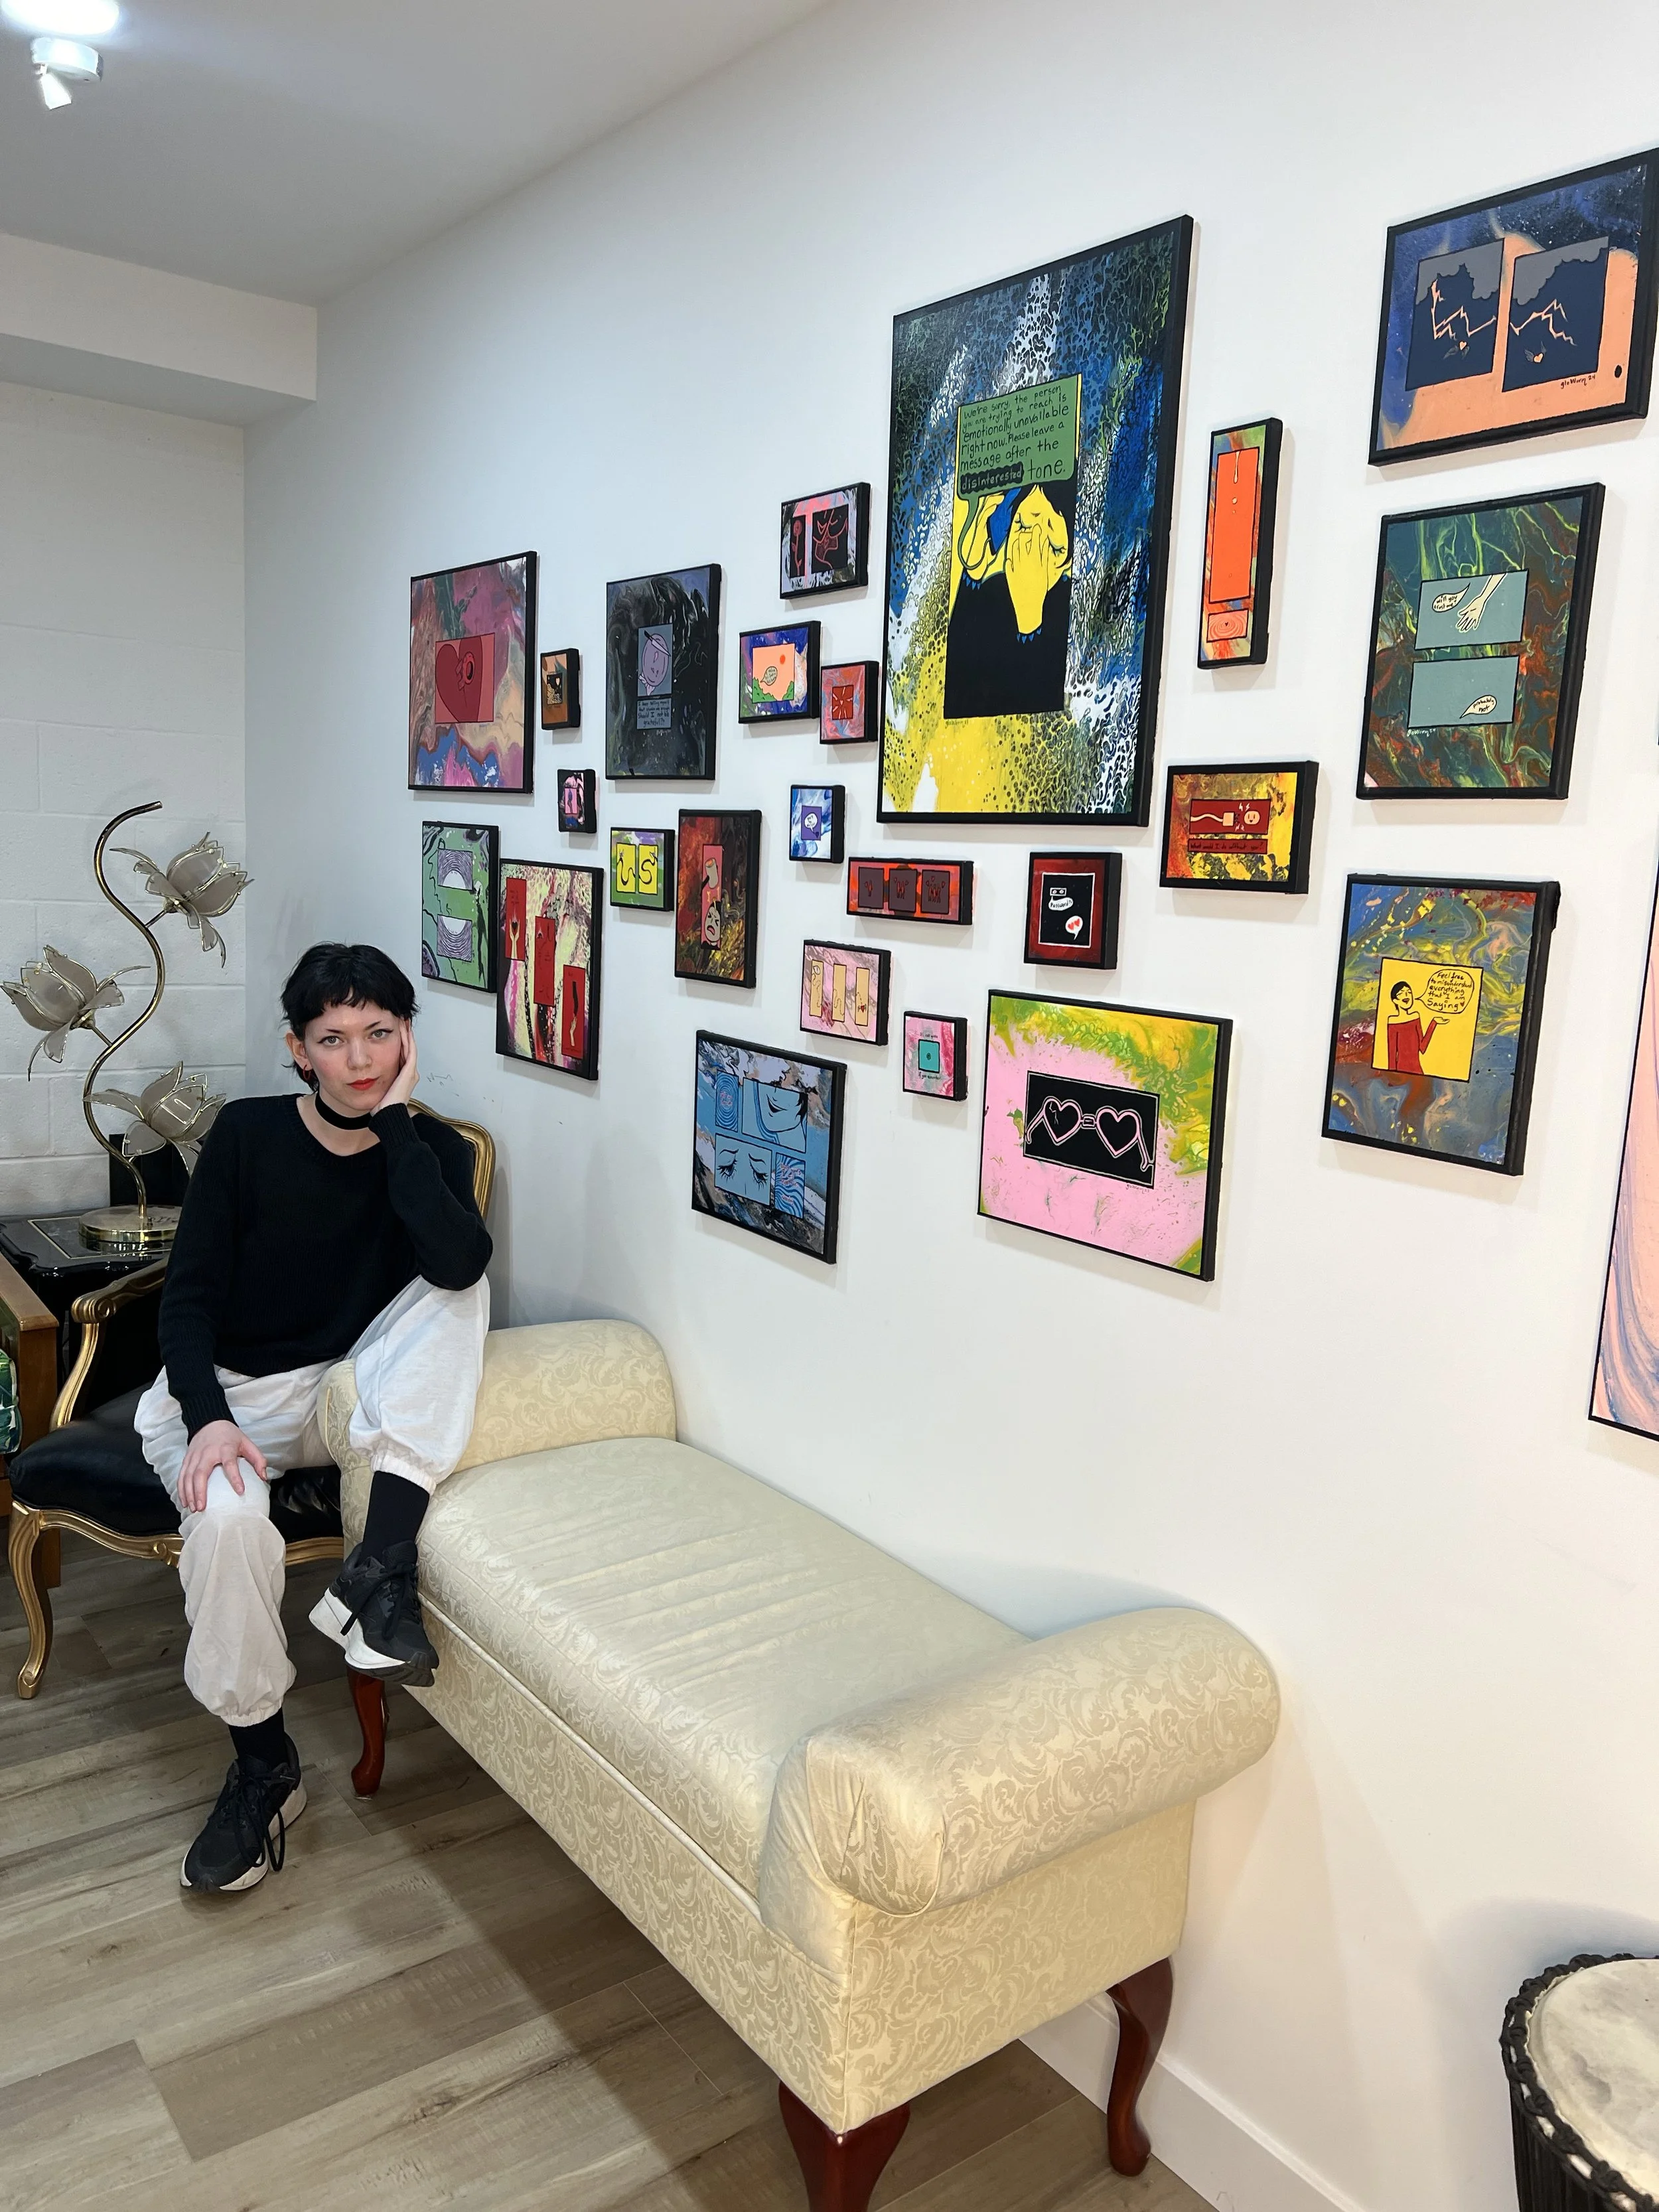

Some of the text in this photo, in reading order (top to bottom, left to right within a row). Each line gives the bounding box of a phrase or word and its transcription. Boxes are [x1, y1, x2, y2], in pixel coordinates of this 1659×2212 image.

[963, 421, 973, 433] you
[988, 410, 1012, 423] trying
[1030, 398, 1053, 410] reach
[1059, 392, 1066, 402] is
[964, 386, 1061, 419] We're sorry, the person
[964, 405, 1069, 443] emotionally unavailable
[960, 438, 1059, 472] message after the
[961, 439, 985, 459] right
[987, 439, 1007, 451] now.
[1008, 432, 1029, 444] Please
[1031, 425, 1054, 437] leave
[962, 459, 1066, 490] disinterested tone.
[1473, 698, 1494, 709] probably
[1429, 986, 1465, 995] everything
